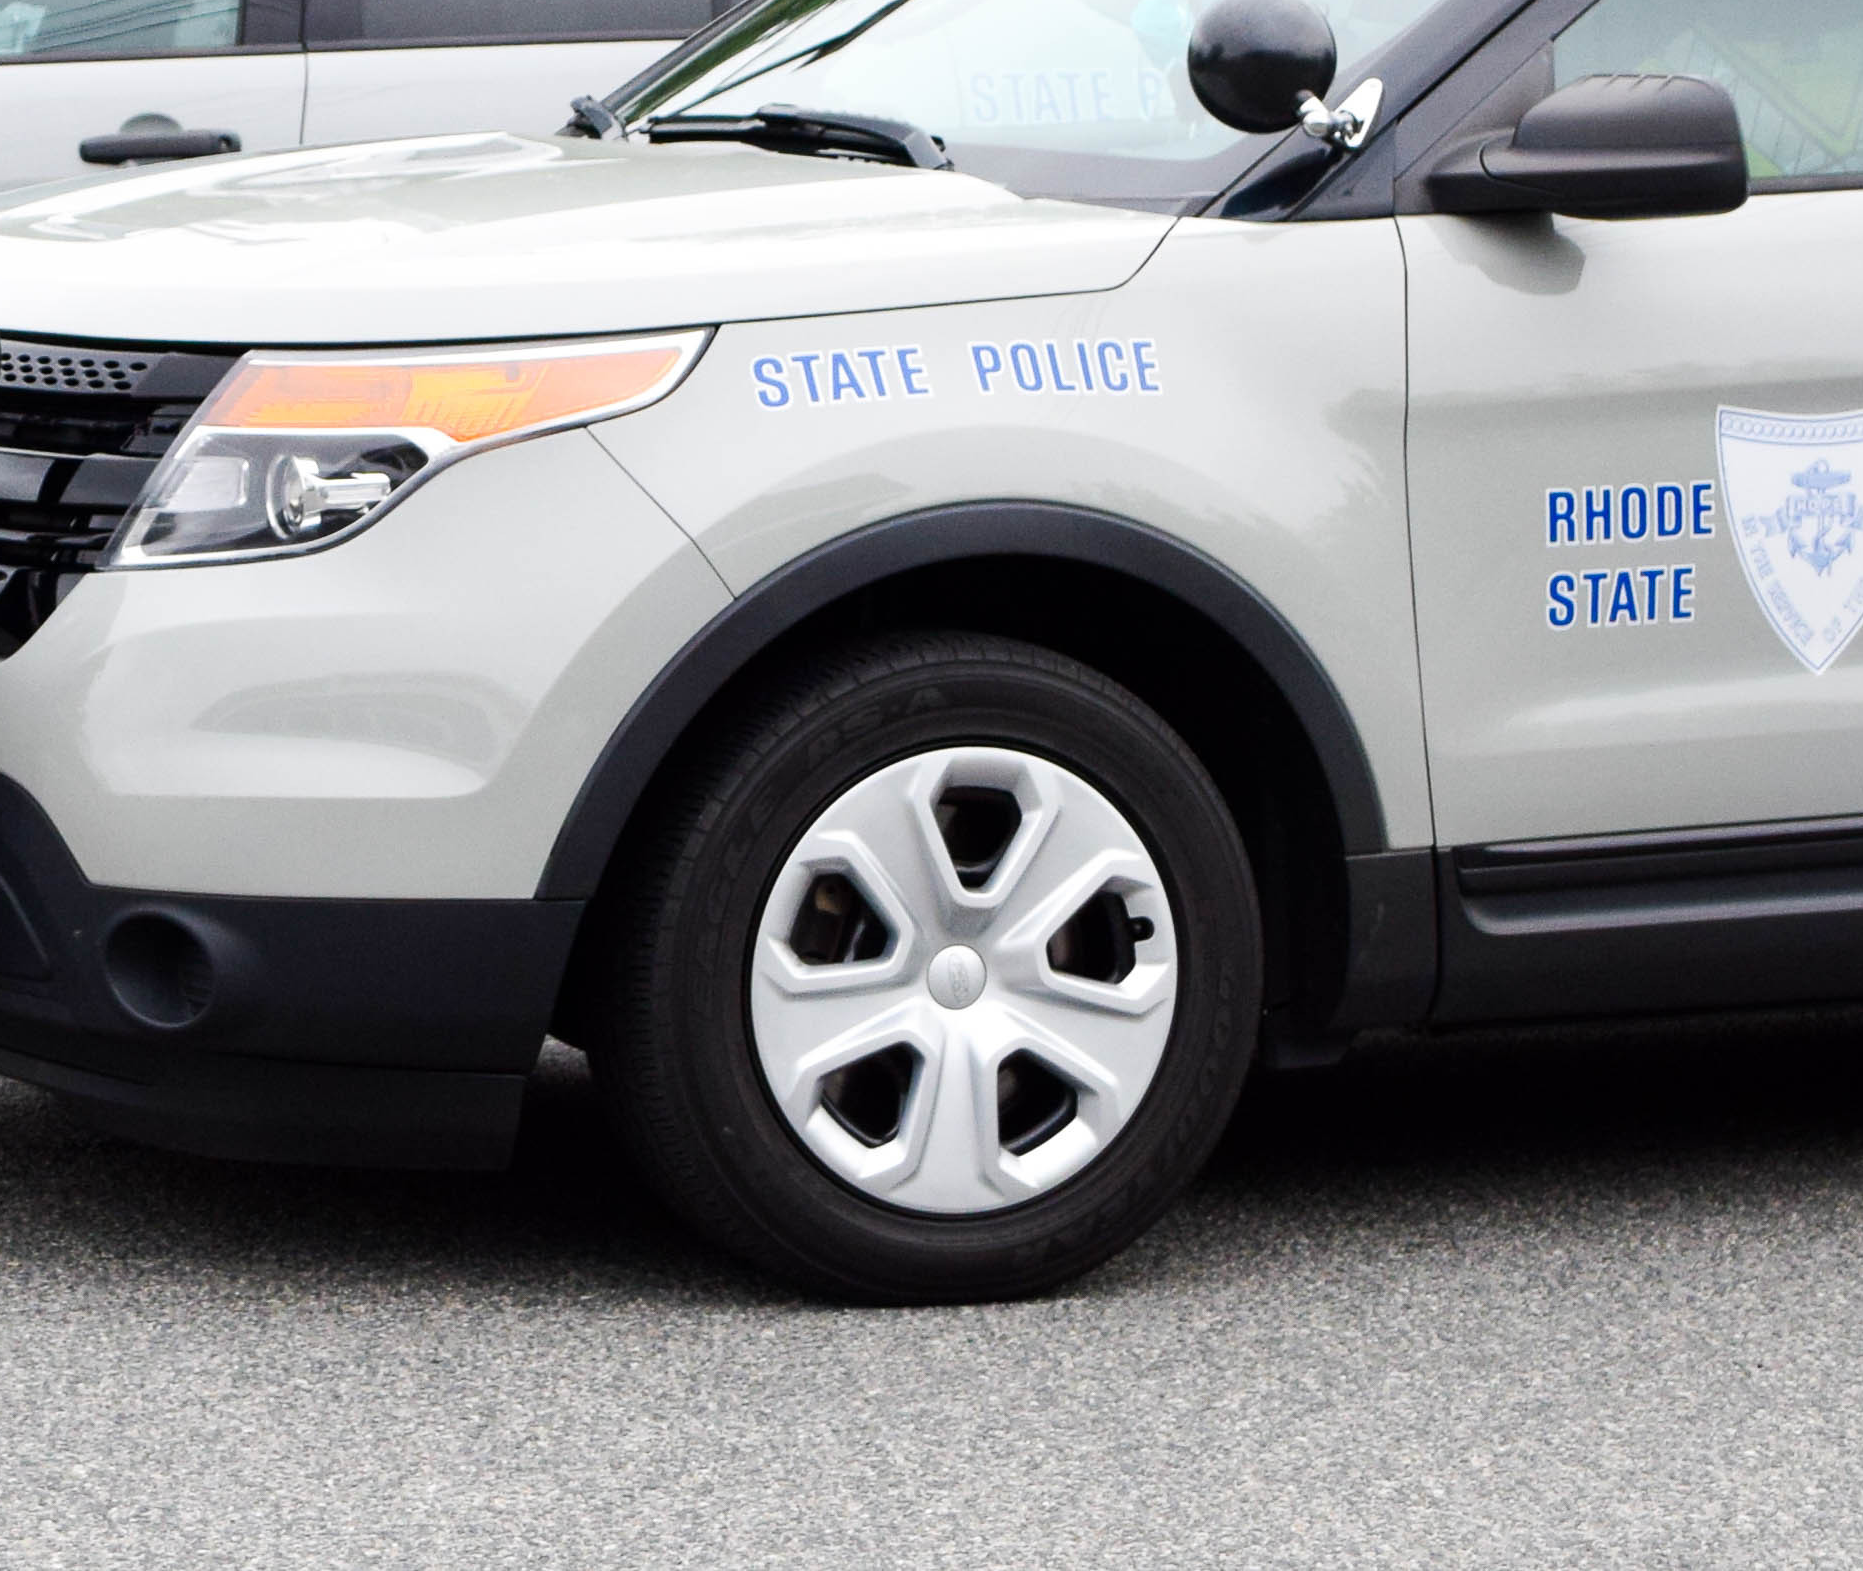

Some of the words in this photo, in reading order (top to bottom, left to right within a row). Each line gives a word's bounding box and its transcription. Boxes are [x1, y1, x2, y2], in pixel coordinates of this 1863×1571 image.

[970, 70, 1116, 123] STATE
[751, 345, 930, 409] STATE
[969, 339, 1160, 393] POLICE
[1546, 482, 1714, 545] RHODE
[1546, 565, 1695, 628] STATE
